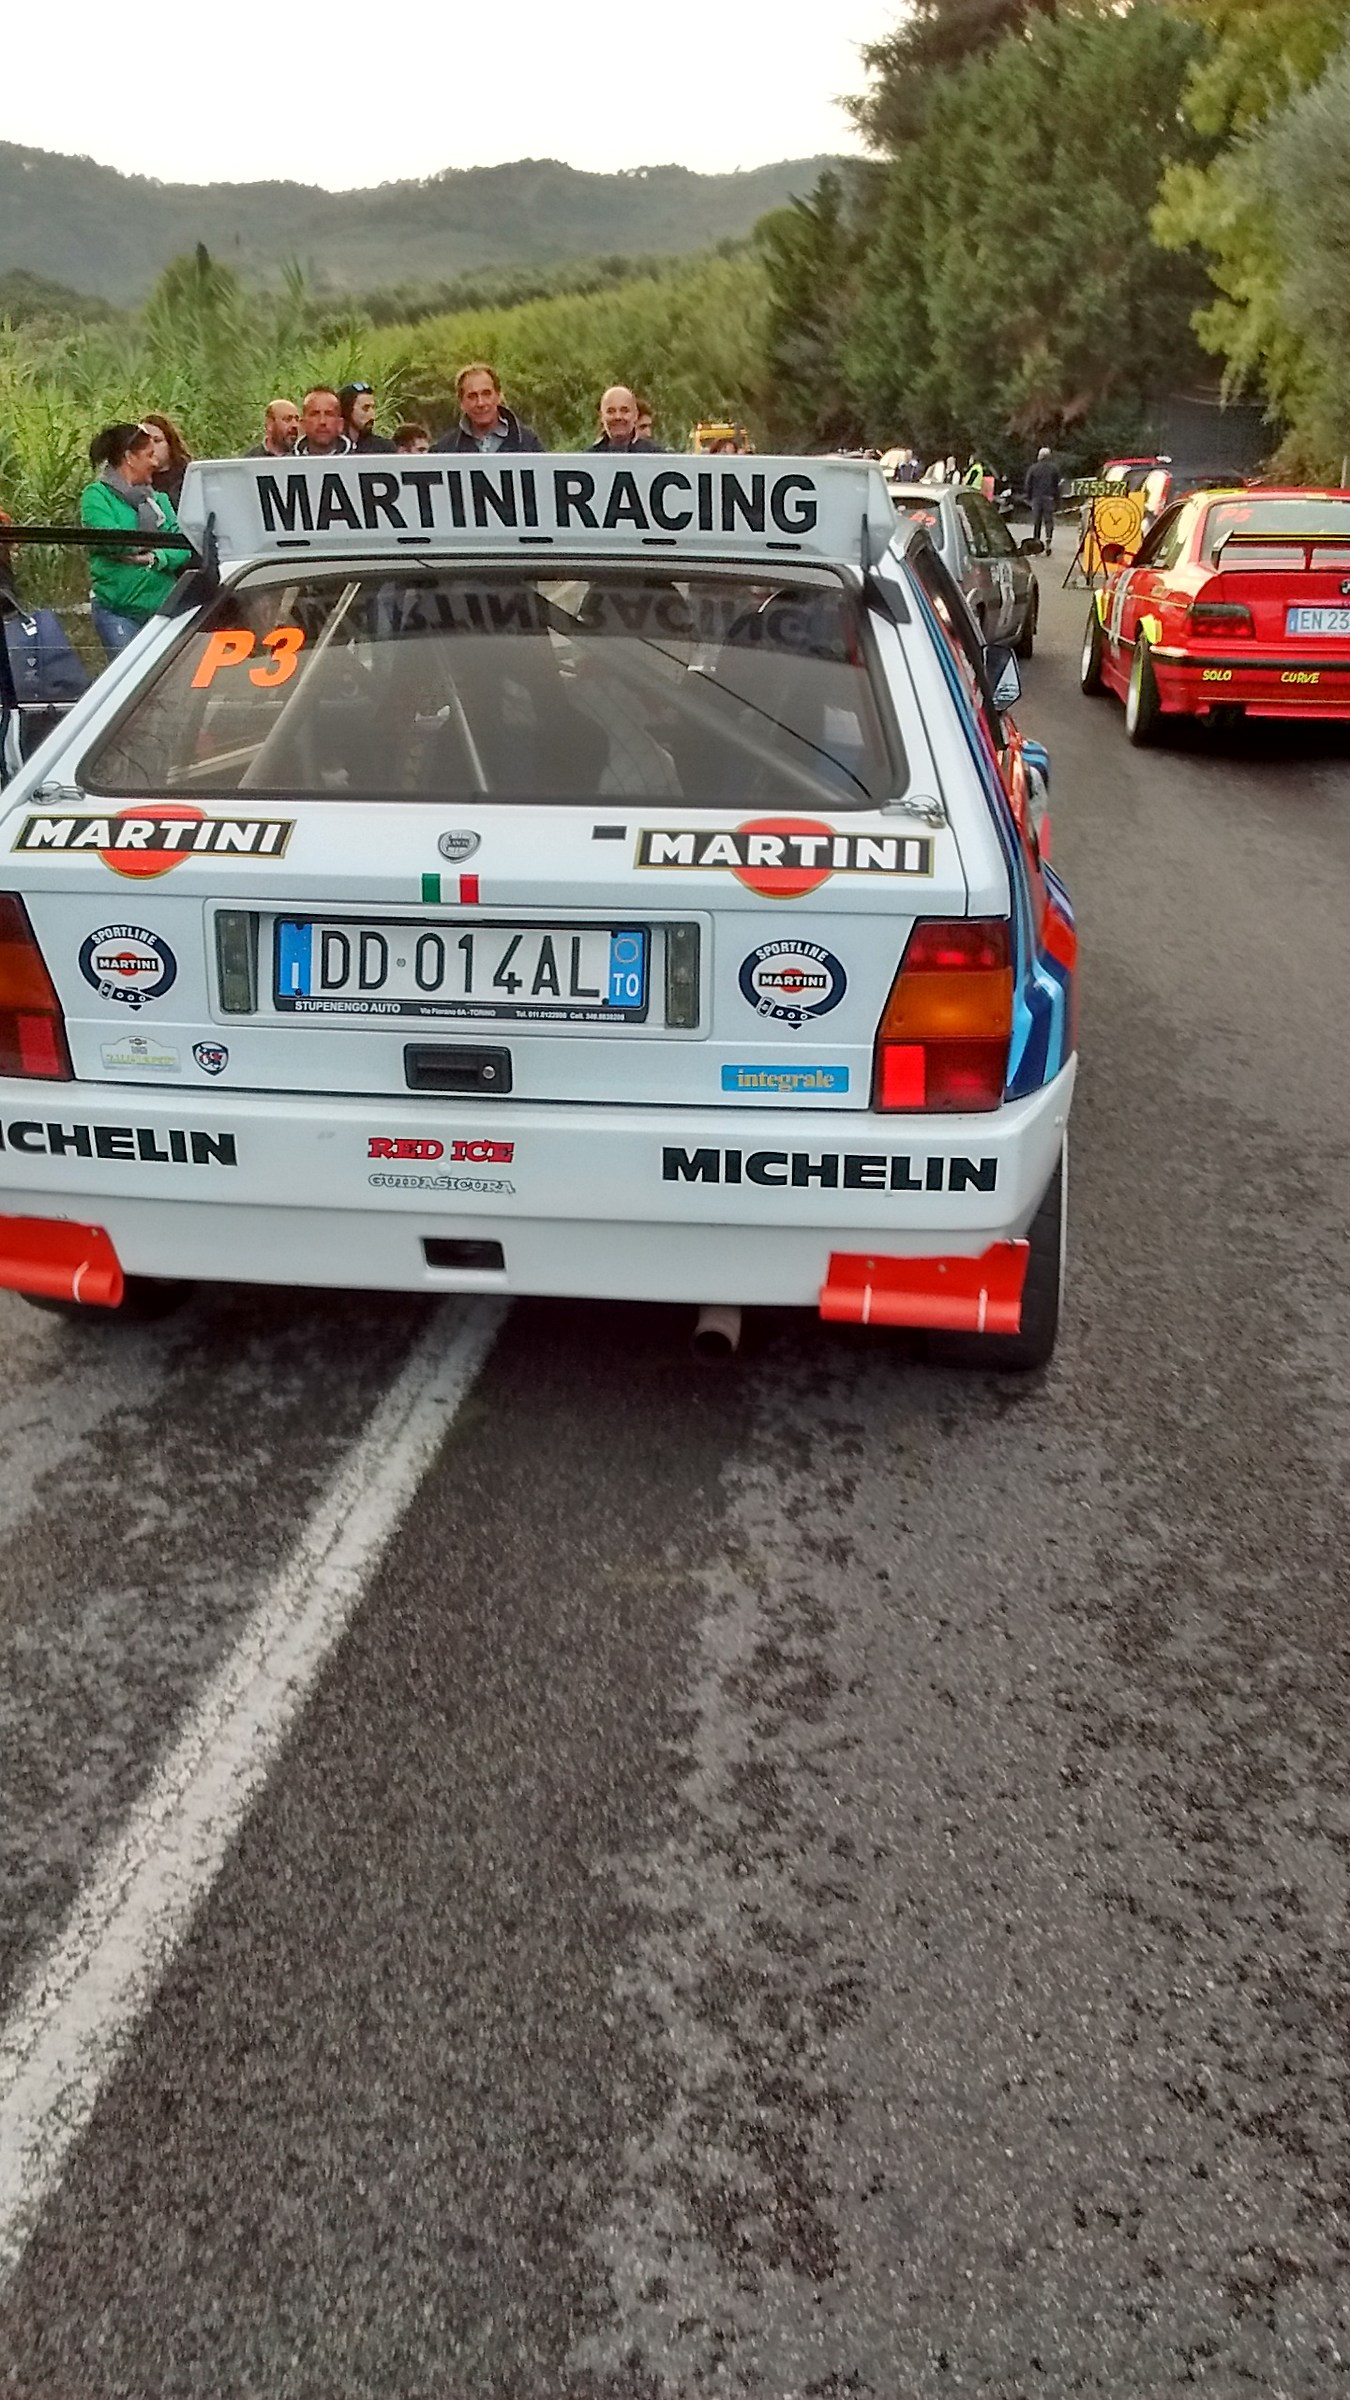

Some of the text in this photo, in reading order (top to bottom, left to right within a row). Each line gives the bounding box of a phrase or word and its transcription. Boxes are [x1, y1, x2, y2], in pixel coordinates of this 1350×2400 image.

[256, 469, 818, 534] MARTINI RACING
[1300, 610, 1323, 630] EN
[190, 626, 306, 688] P3
[1202, 669, 1321, 684] SOLO CURVE
[24, 819, 282, 852] MARTINI
[649, 833, 921, 871] MARTINI
[91, 926, 158, 946] SPORTLINE
[755, 941, 829, 962] SPORTLINE
[99, 959, 156, 969] MARTINI
[613, 972, 640, 996] TO
[761, 975, 824, 987] MARTINI
[295, 1001, 401, 1013] STUPENENGO AUTO
[737, 1068, 834, 1093] integrale
[368, 1137, 515, 1163] RED ICE
[662, 1146, 998, 1191] MICHELIN
